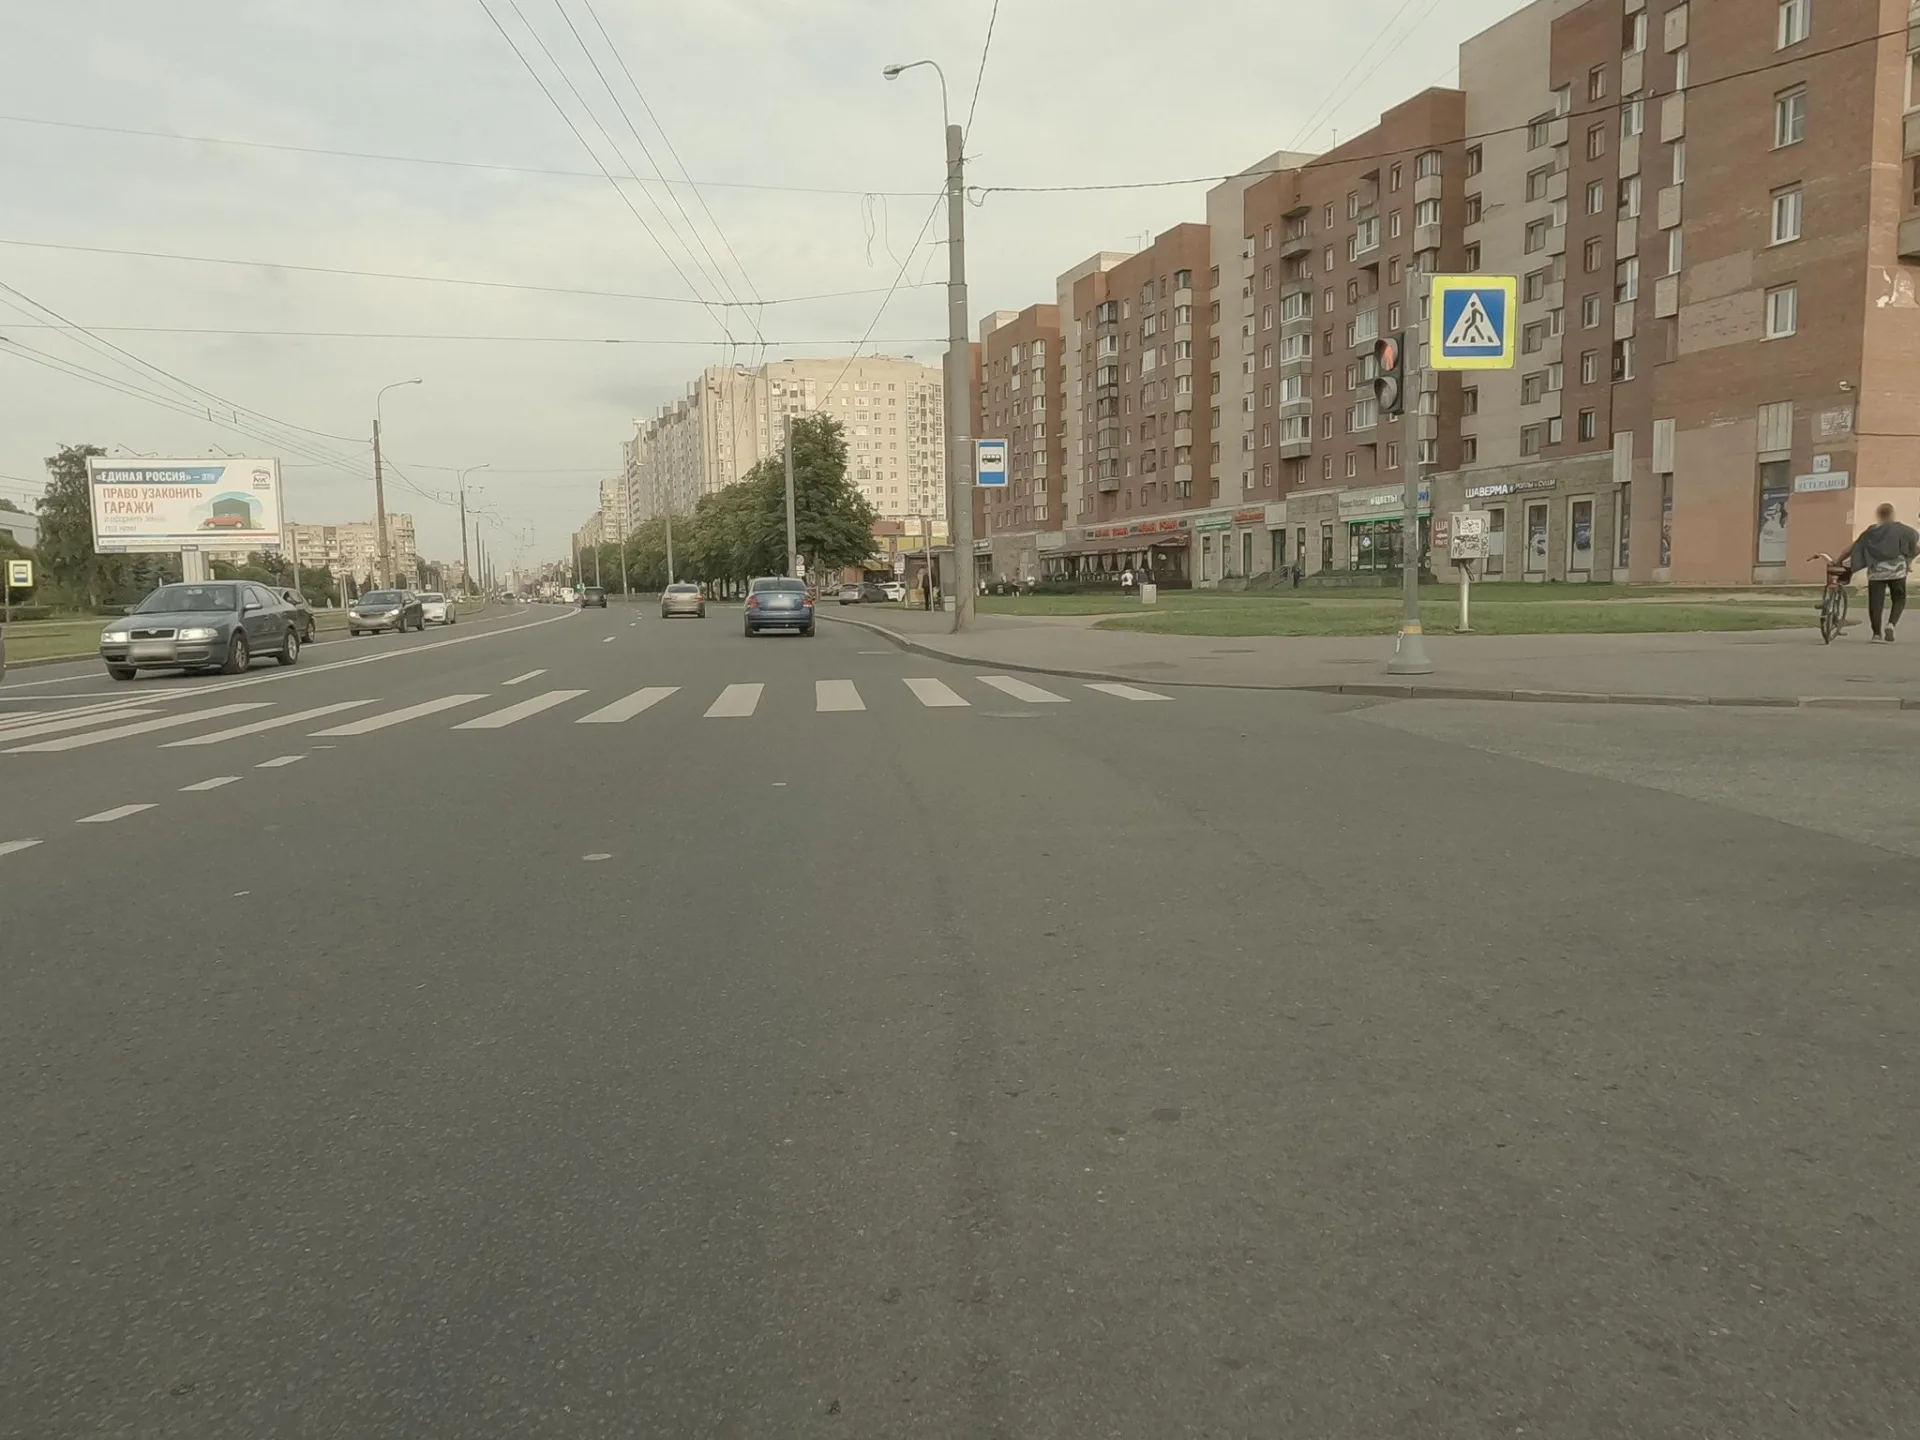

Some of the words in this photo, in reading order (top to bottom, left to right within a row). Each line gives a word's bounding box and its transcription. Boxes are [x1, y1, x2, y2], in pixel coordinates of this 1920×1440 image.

[102, 487, 138, 499] ПРАВО
[142, 487, 203, 500] УЗАКОНИТЬ
[1465, 484, 1508, 498] ШАВЕРМА
[104, 501, 154, 514] ГАРАЖИ
